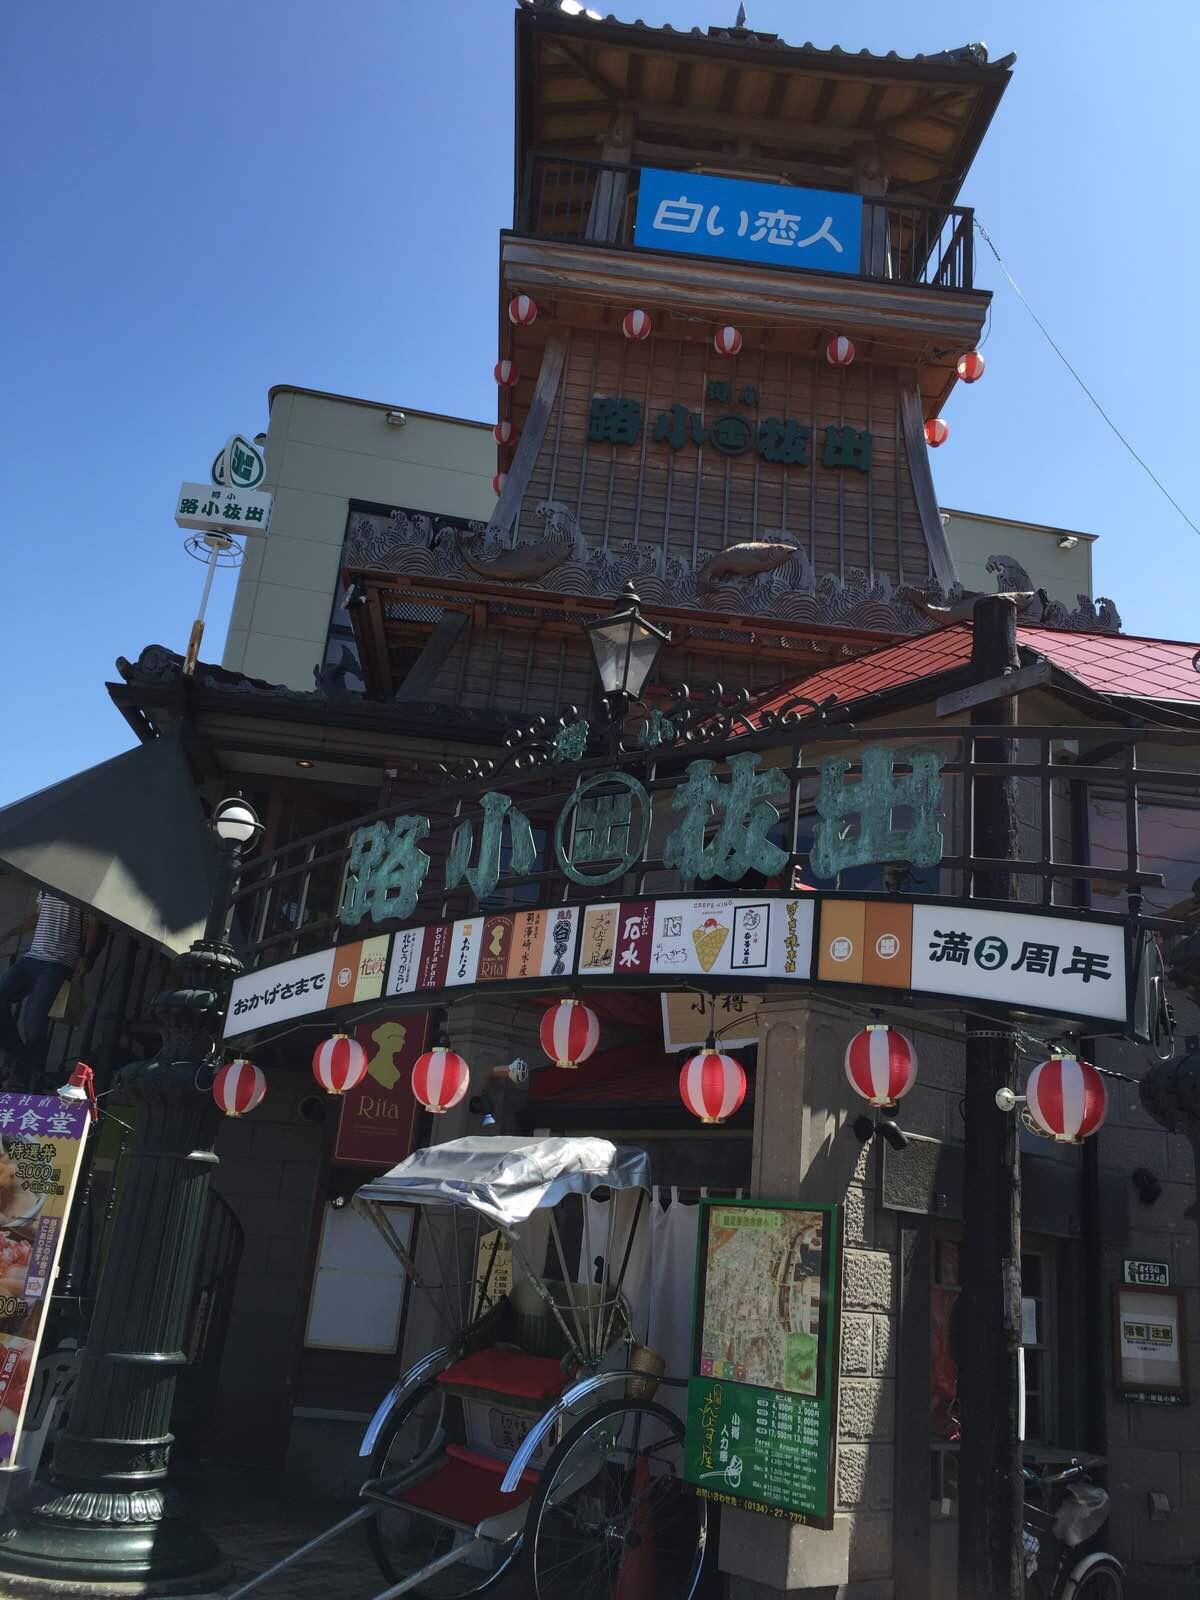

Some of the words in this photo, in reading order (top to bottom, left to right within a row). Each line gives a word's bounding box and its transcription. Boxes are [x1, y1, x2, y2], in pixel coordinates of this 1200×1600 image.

[653, 195, 844, 254] 白い恋人
[395, 933, 411, 992] 北とうがらし
[458, 938, 470, 977] おたる
[619, 915, 643, 968] 石水
[481, 961, 503, 977] Rita
[233, 973, 326, 1015] おかげさまで
[358, 1096, 399, 1119] Rita
